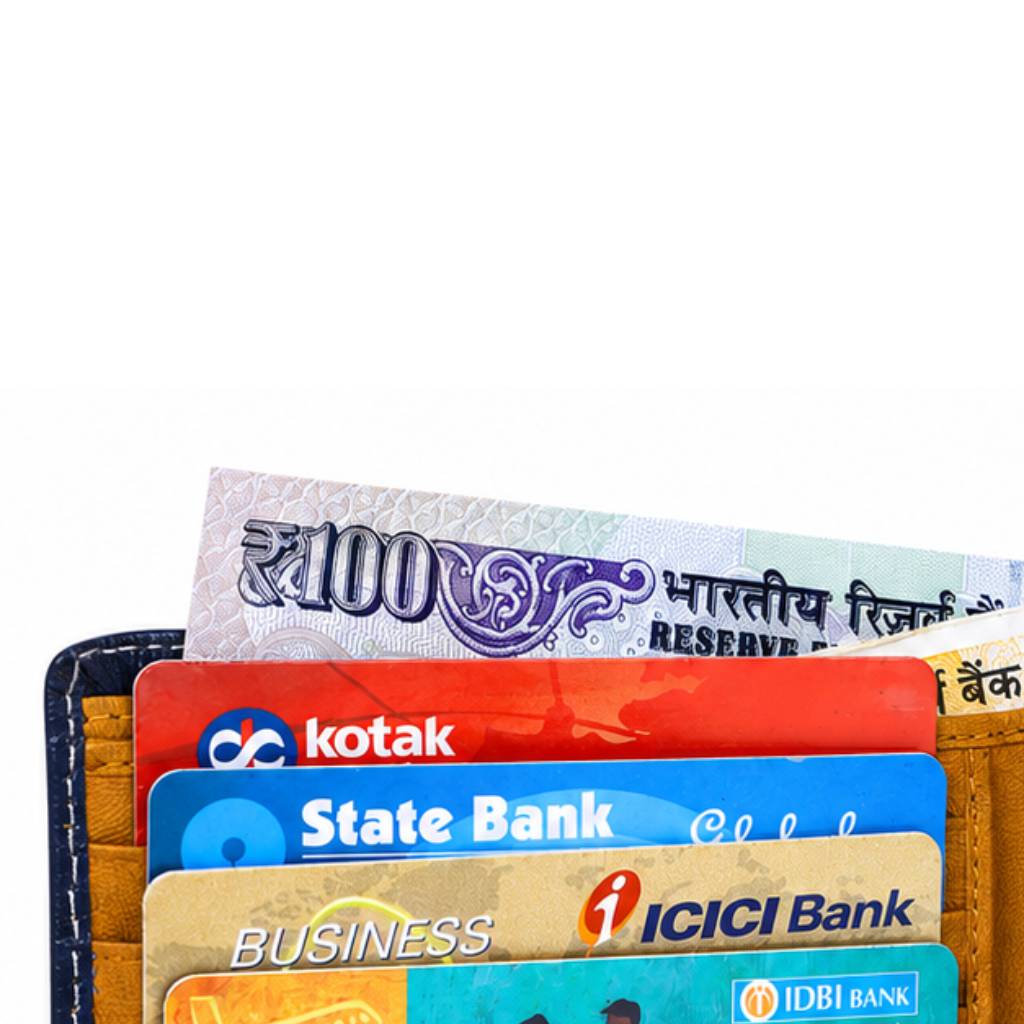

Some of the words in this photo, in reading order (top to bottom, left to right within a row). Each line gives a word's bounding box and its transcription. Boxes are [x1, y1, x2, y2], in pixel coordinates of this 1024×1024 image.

[662, 568, 834, 631] भारतीय
[649, 620, 799, 656] RESERVE
[957, 659, 1022, 705] बैंक
[305, 715, 456, 759] kotak
[301, 798, 453, 848] State
[472, 791, 614, 843] Bank
[640, 896, 780, 944] ICICI
[787, 889, 916, 934] Bank
[230, 915, 495, 969] BUSINESS
[785, 983, 844, 1013] IDBI
[850, 986, 910, 1009] BANK
